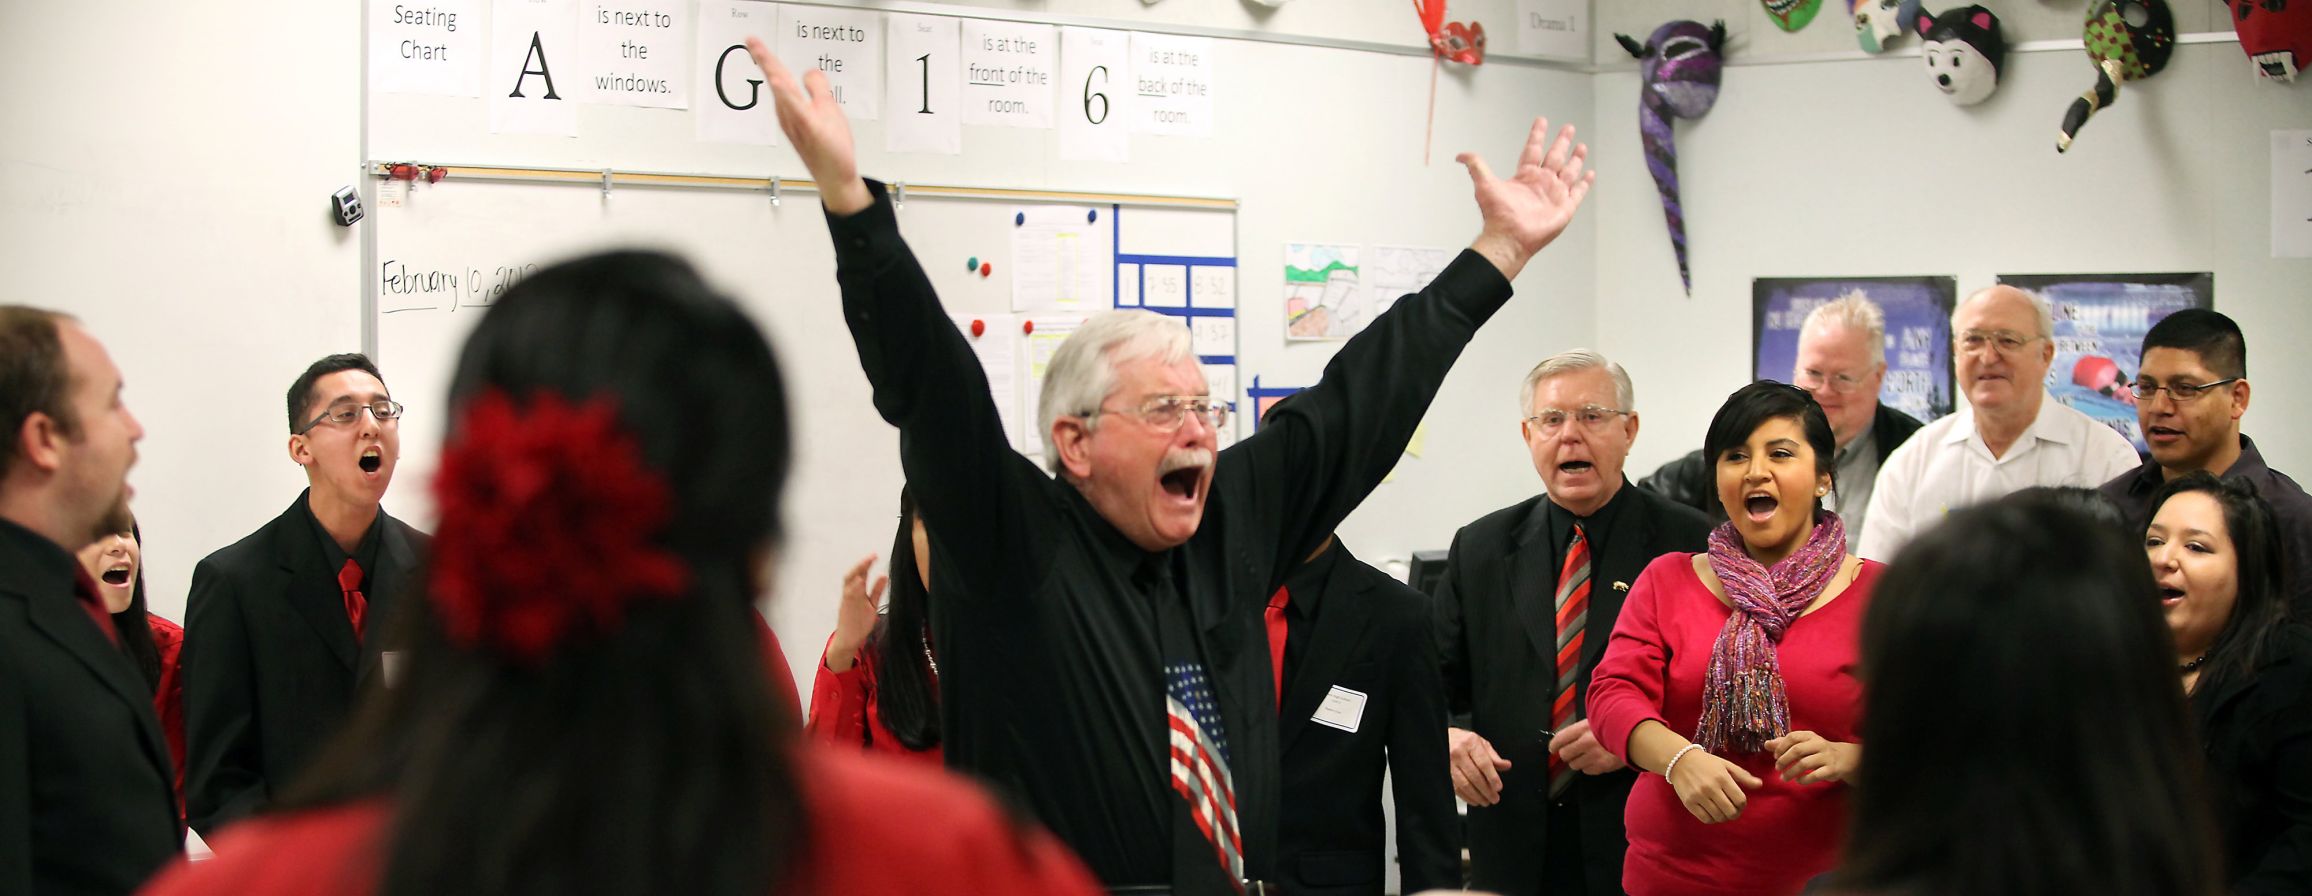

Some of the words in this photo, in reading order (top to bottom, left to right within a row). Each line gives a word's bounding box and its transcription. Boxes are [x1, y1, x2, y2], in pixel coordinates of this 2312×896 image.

[393, 4, 457, 33] Seating
[598, 5, 609, 24] is
[615, 10, 651, 27] next
[655, 11, 671, 28] to
[731, 7, 749, 18] Row
[797, 20, 808, 38] is
[813, 25, 845, 41] next
[849, 26, 865, 43] to
[400, 39, 447, 62] Chart
[621, 39, 648, 60] the
[983, 33, 993, 51] is
[998, 37, 1011, 52] at
[1014, 36, 1037, 54] the
[508, 30, 562, 101] A
[818, 53, 843, 72] the
[1150, 47, 1160, 64] is
[1163, 50, 1175, 65] at
[1178, 49, 1199, 67] the
[595, 72, 671, 94] windows.
[715, 44, 764, 110] G
[916, 53, 934, 115] 1
[969, 62, 1005, 82] front
[1009, 66, 1023, 83] of
[1027, 68, 1048, 85] the
[1083, 65, 1109, 125] 6
[1138, 75, 1167, 93] back
[1171, 77, 1184, 95] of
[1187, 80, 1207, 97] the
[988, 99, 1030, 114] room.
[382, 260, 457, 312] February
